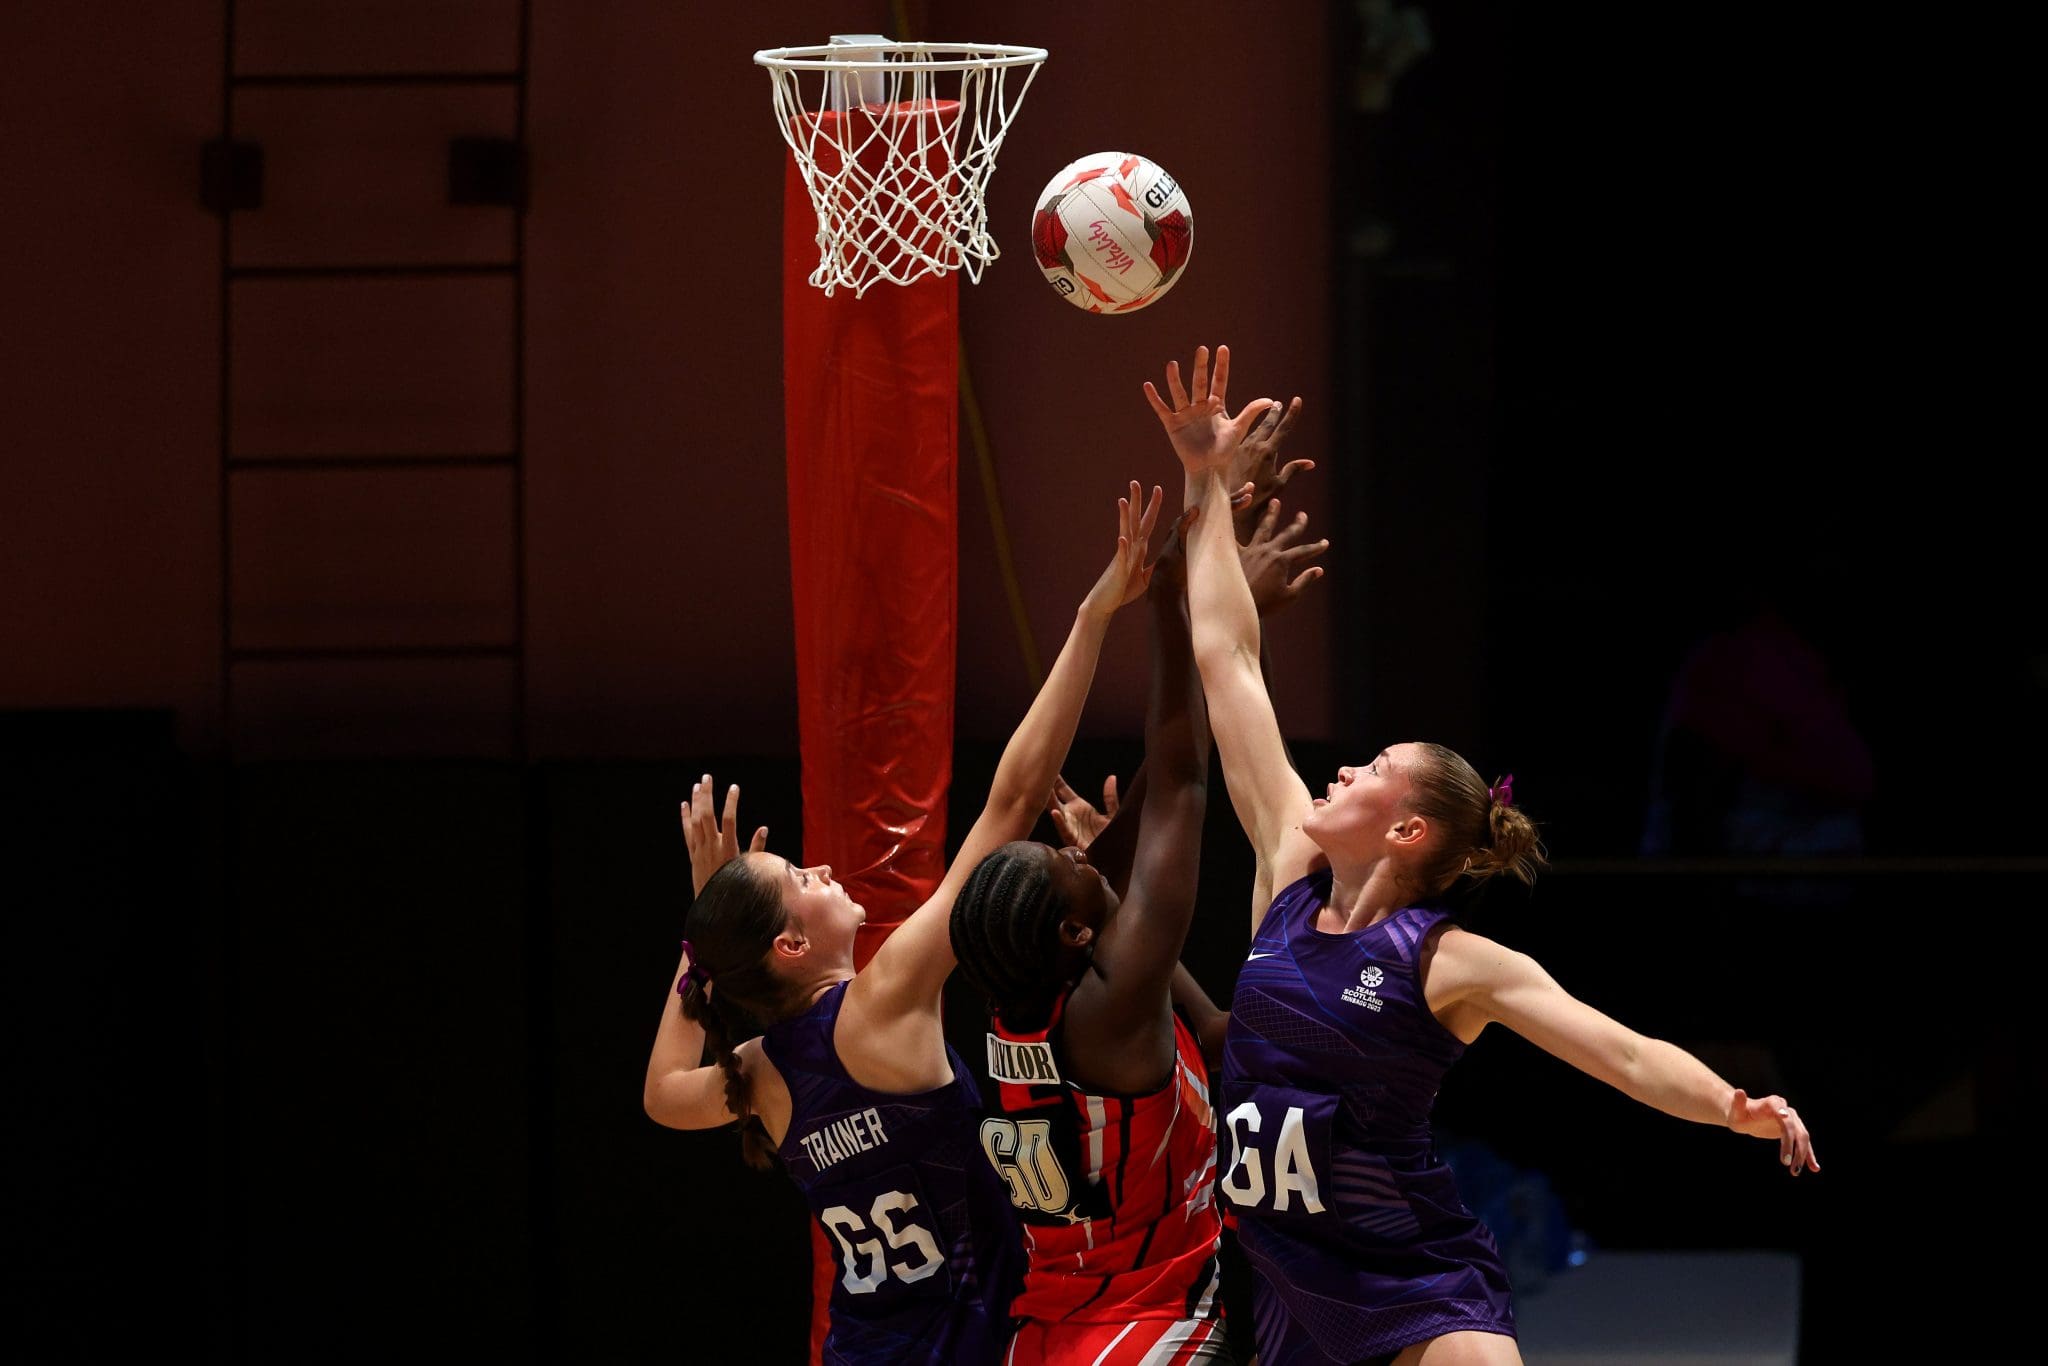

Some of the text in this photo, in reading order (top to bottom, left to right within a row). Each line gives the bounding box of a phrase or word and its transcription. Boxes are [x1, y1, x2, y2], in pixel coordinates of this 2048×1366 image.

[1088, 220, 1135, 275] Vitality
[1343, 988, 1384, 1006] SCOTLAND
[1355, 985, 1377, 997] TEAM
[990, 1037, 1056, 1080] TAYLOR
[800, 1107, 889, 1172] TRAINER
[979, 1117, 1070, 1214] GD
[1221, 1102, 1327, 1215] GA
[821, 1190, 945, 1295] GS
